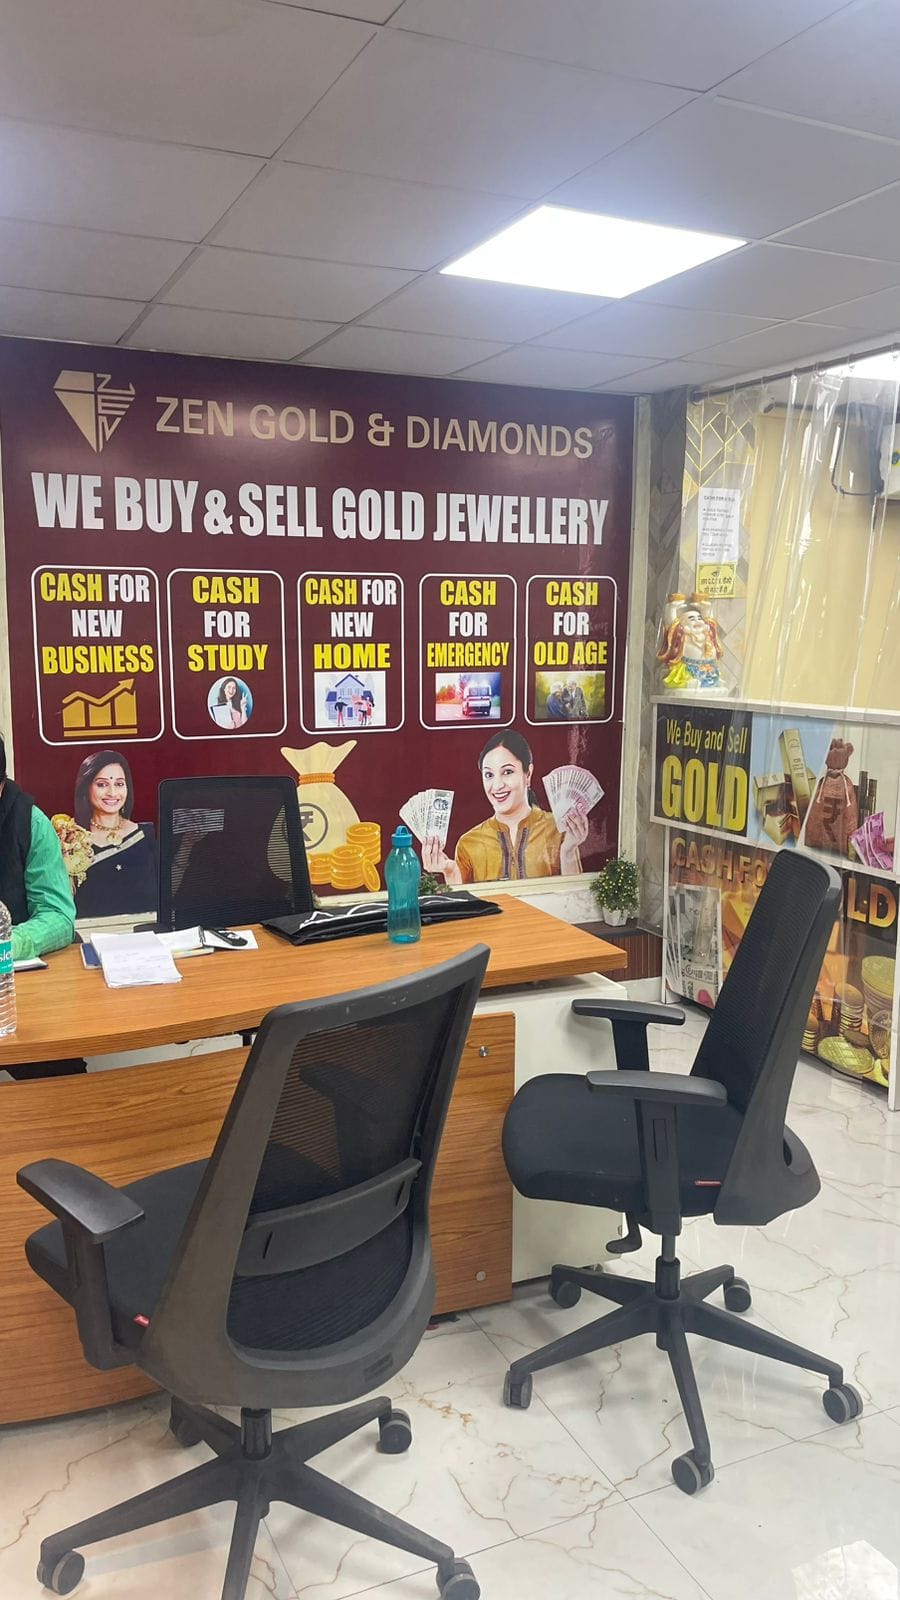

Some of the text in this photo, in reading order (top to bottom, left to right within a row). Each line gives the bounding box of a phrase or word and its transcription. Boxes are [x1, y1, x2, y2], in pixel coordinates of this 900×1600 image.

[156, 397, 593, 459] ZEN GOLD & DIAMONDS
[31, 472, 608, 545] WE BUY & SELL GOLD JEWELLERY
[41, 573, 150, 603] CASH FOR
[193, 576, 260, 604] CASH
[306, 578, 397, 606] CASH FOR
[441, 580, 497, 606] CASH
[546, 581, 599, 607] CASH
[72, 610, 123, 638] NEW
[204, 611, 251, 639] FOR
[331, 612, 374, 638] NEW
[449, 612, 488, 637] FOR
[554, 612, 590, 636] FOR
[42, 645, 154, 675] BUSINESS
[188, 645, 269, 672] STUDY
[314, 644, 391, 670] HOME
[428, 642, 510, 668] EMERGENCY
[534, 641, 608, 666] OLD AGE
[666, 719, 748, 754] We Buy and Sell
[662, 755, 748, 832] GOLD
[671, 837, 734, 881] CASH
[739, 856, 771, 888] FO
